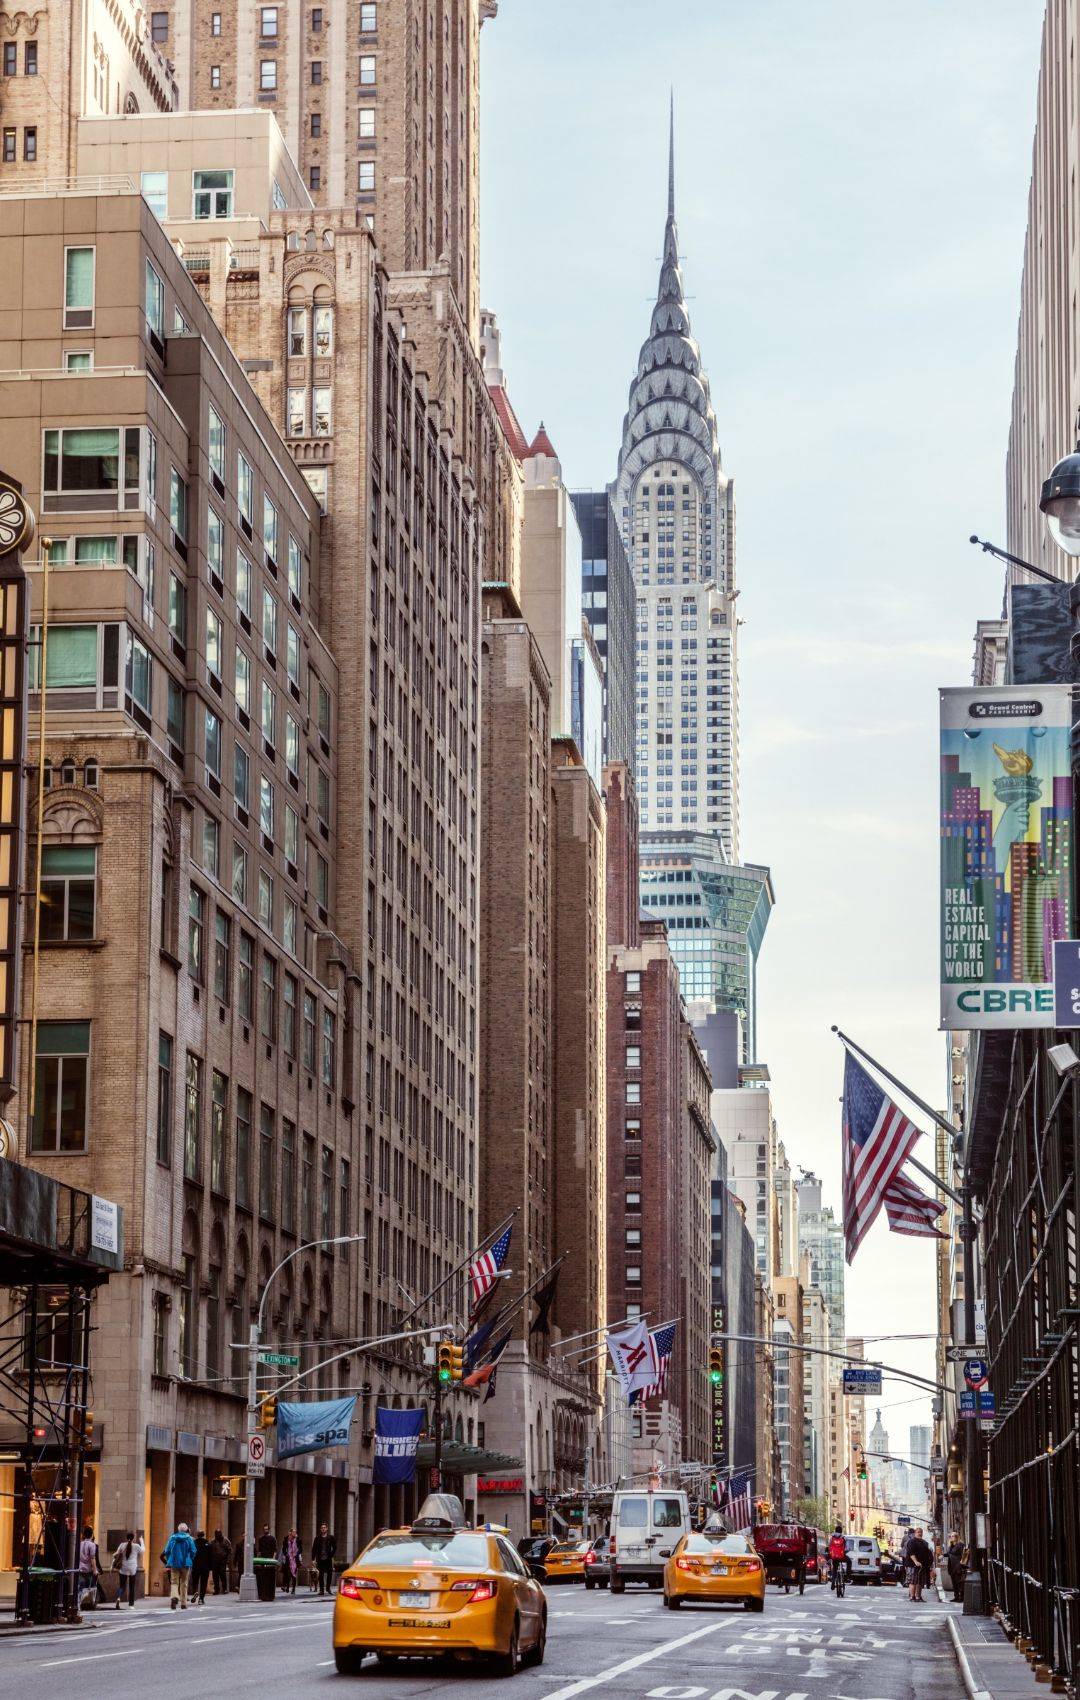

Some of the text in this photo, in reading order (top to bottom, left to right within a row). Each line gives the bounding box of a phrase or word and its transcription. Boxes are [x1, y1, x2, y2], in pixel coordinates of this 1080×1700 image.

[945, 888, 973, 904] REAL
[945, 906, 985, 922] ESTATE
[945, 924, 990, 940] CAPITAL
[945, 942, 983, 959] OF THE
[945, 961, 984, 977] WORLD
[957, 989, 1054, 1012] CBRE
[714, 1309, 723, 1350] HOTE
[616, 1350, 630, 1385] MARRIOTT
[714, 1382, 723, 1406] GER
[714, 1410, 723, 1450] SMITH
[740, 1632, 904, 1648] ONLY
